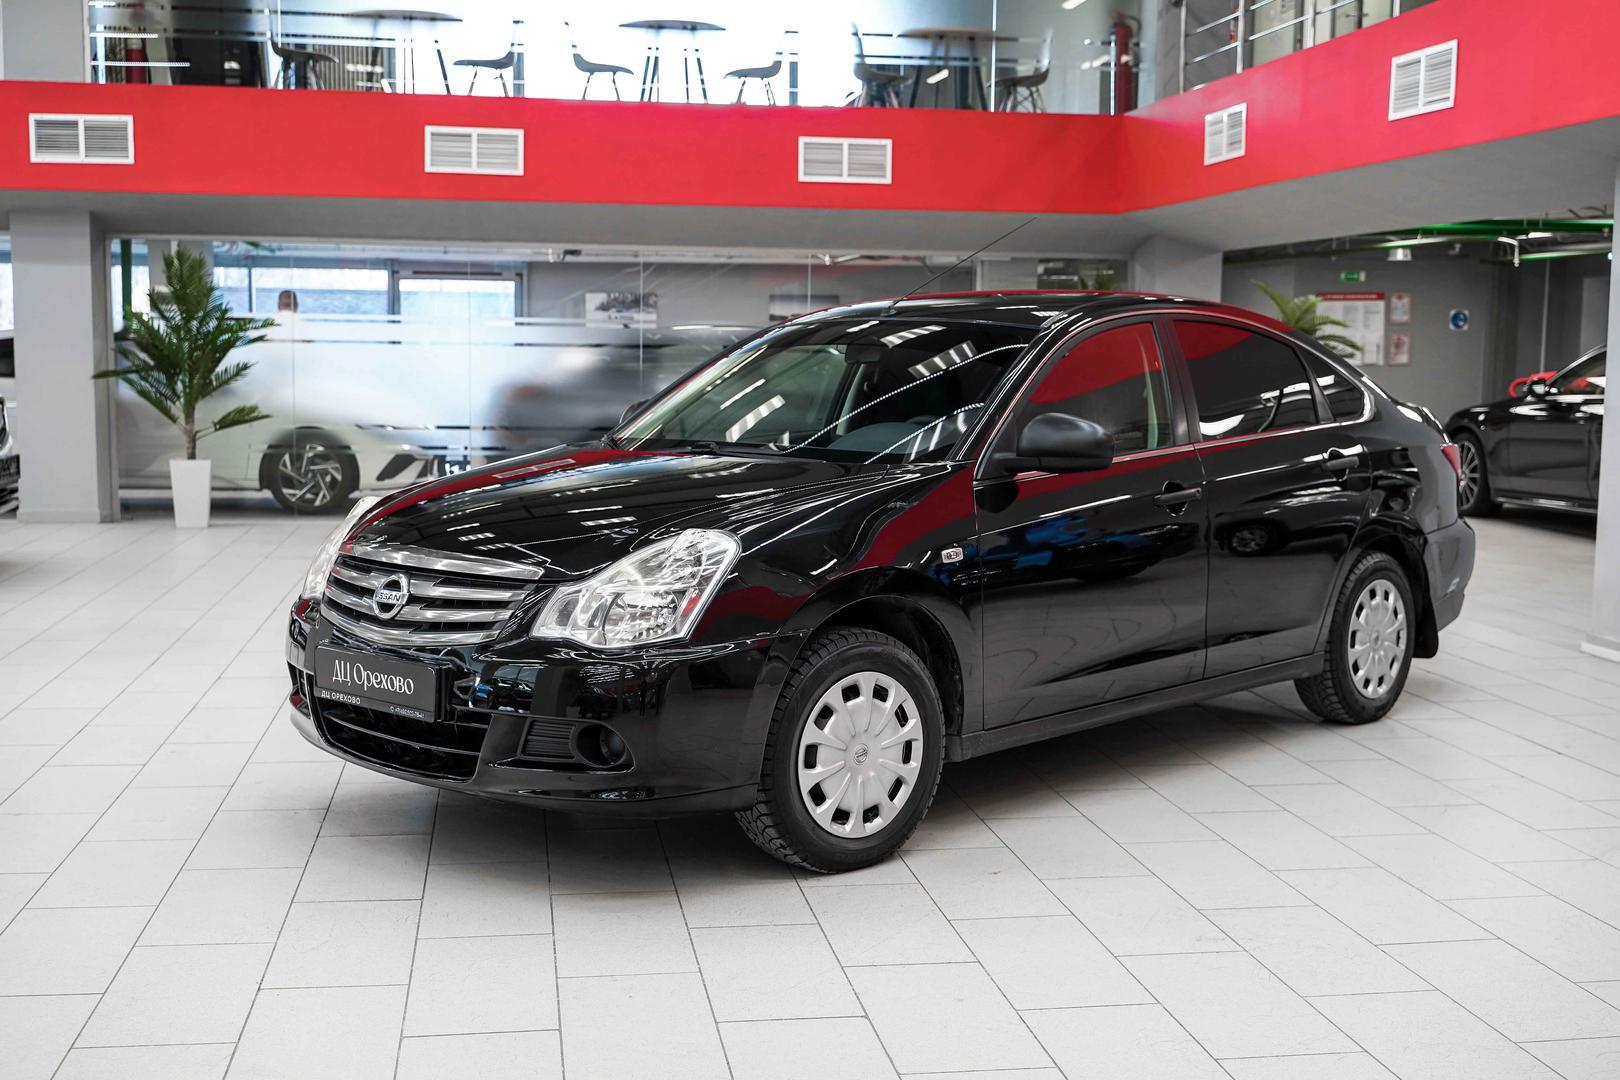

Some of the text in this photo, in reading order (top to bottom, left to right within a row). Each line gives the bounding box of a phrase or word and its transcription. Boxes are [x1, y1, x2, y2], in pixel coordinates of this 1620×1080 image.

[375, 590, 401, 602] SSAN
[333, 660, 414, 694] ДЦ Орехово
[332, 692, 361, 704] ОРЕХОВО
